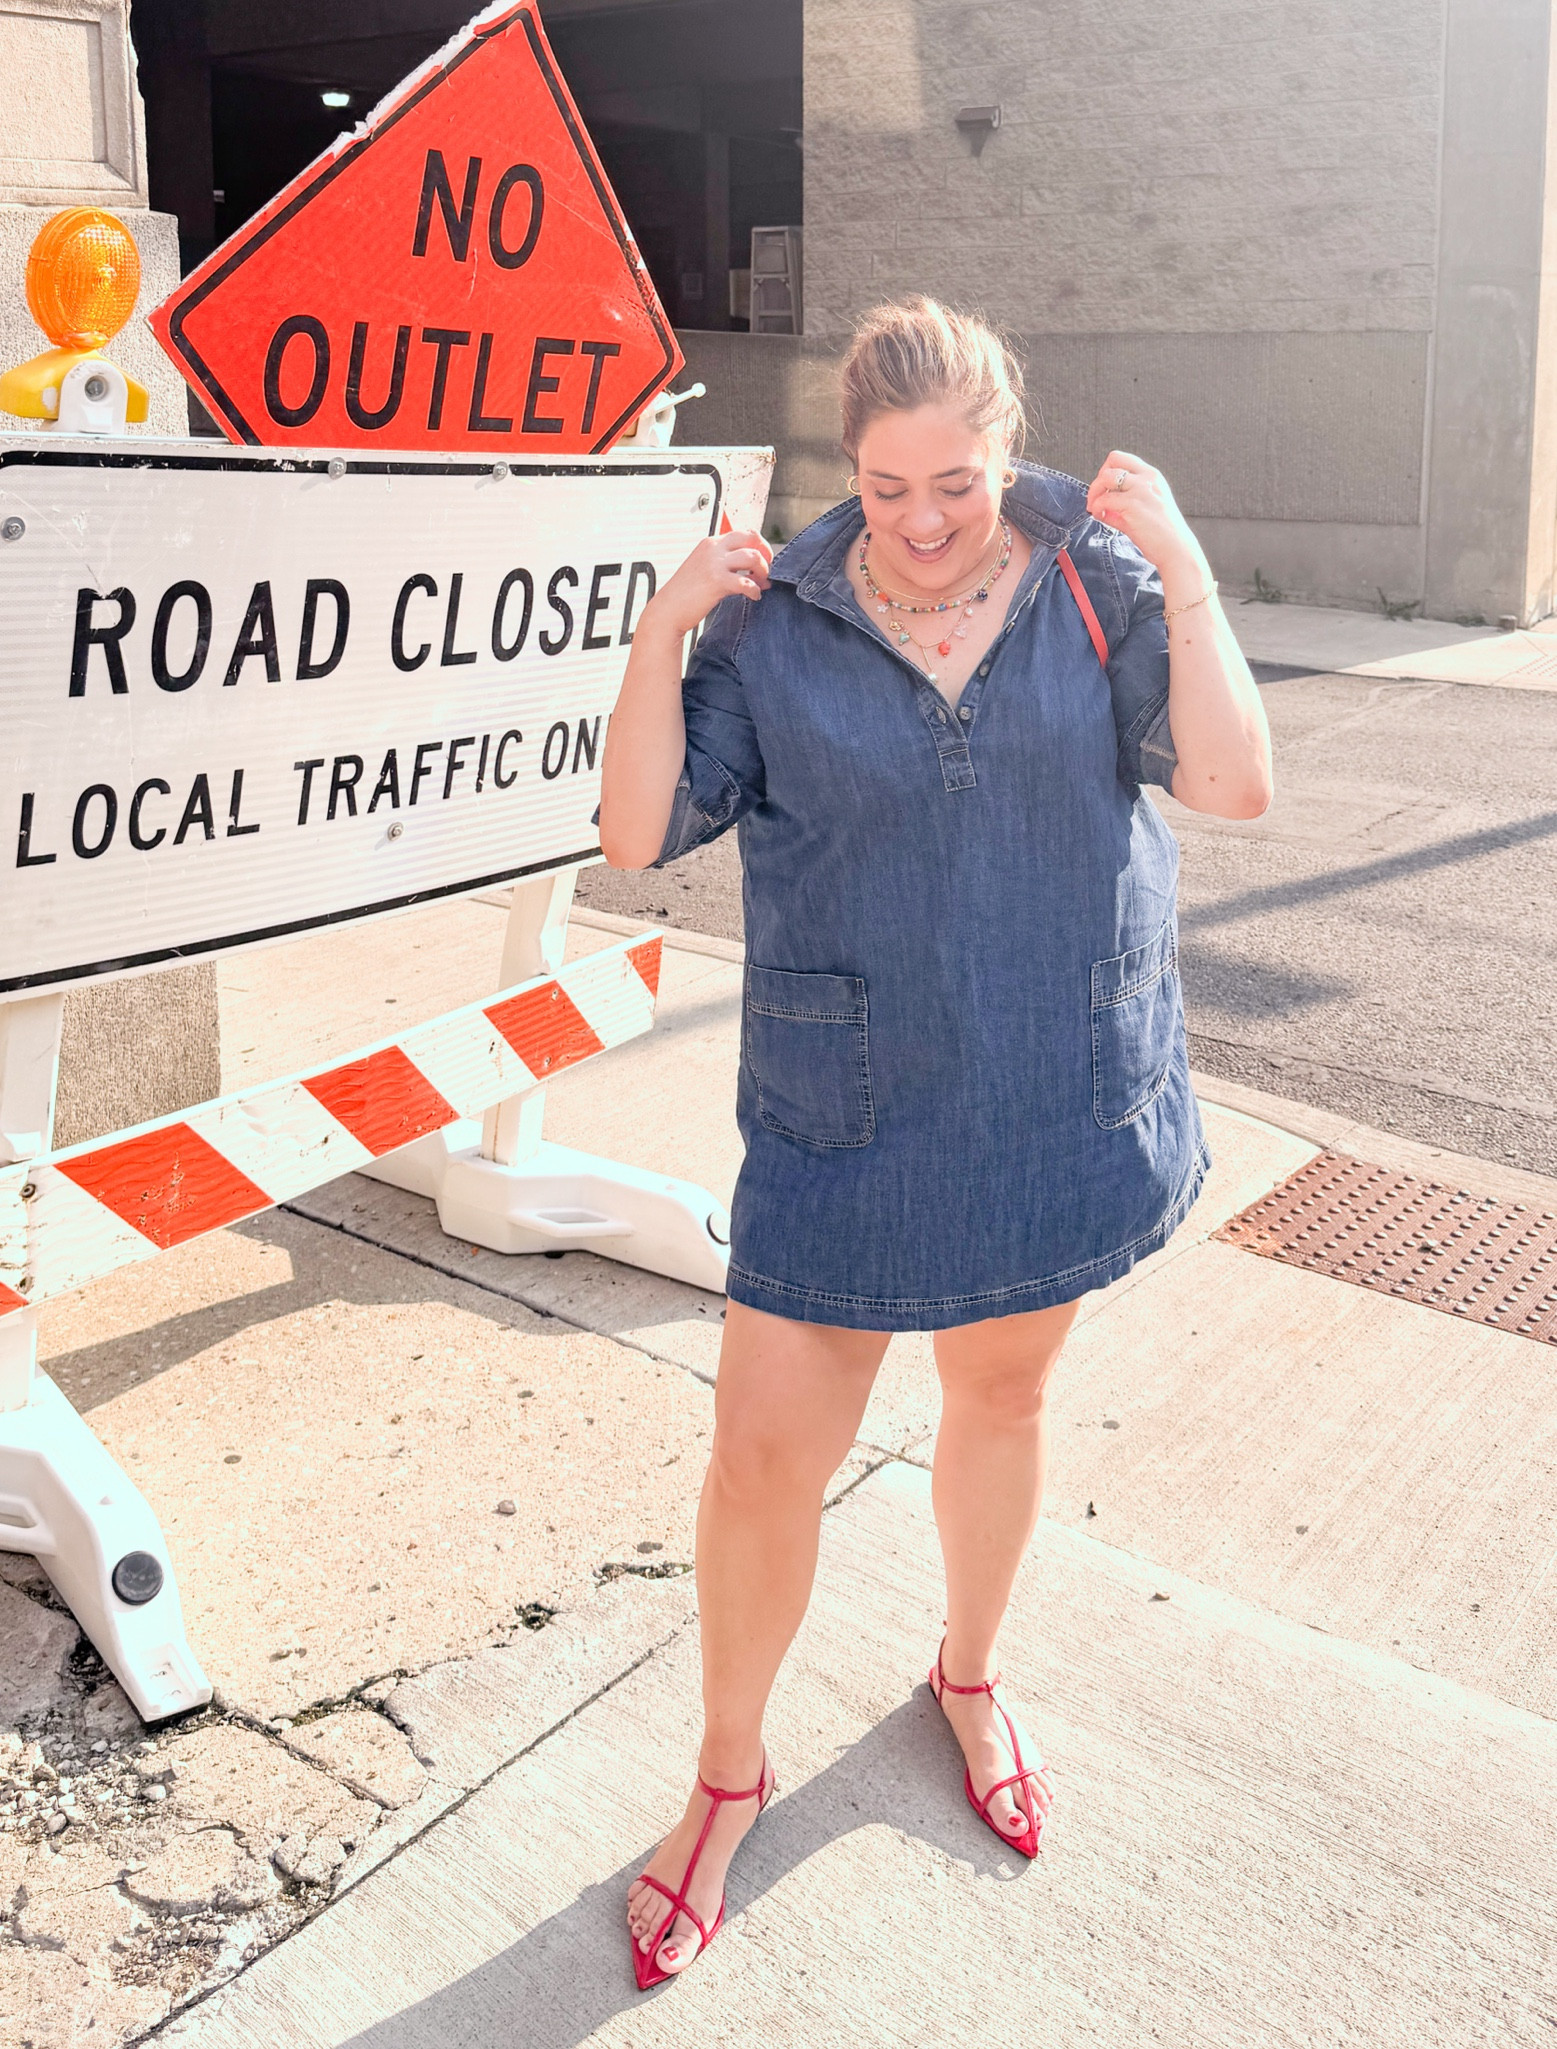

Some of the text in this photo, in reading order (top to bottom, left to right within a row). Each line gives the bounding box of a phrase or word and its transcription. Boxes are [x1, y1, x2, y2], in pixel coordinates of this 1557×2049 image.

[412, 149, 545, 270] NO
[263, 314, 621, 435] OUTLET
[68, 561, 657, 698] ROAD CLOSED
[15, 713, 612, 867] LOCAL TRAFFIC ON
